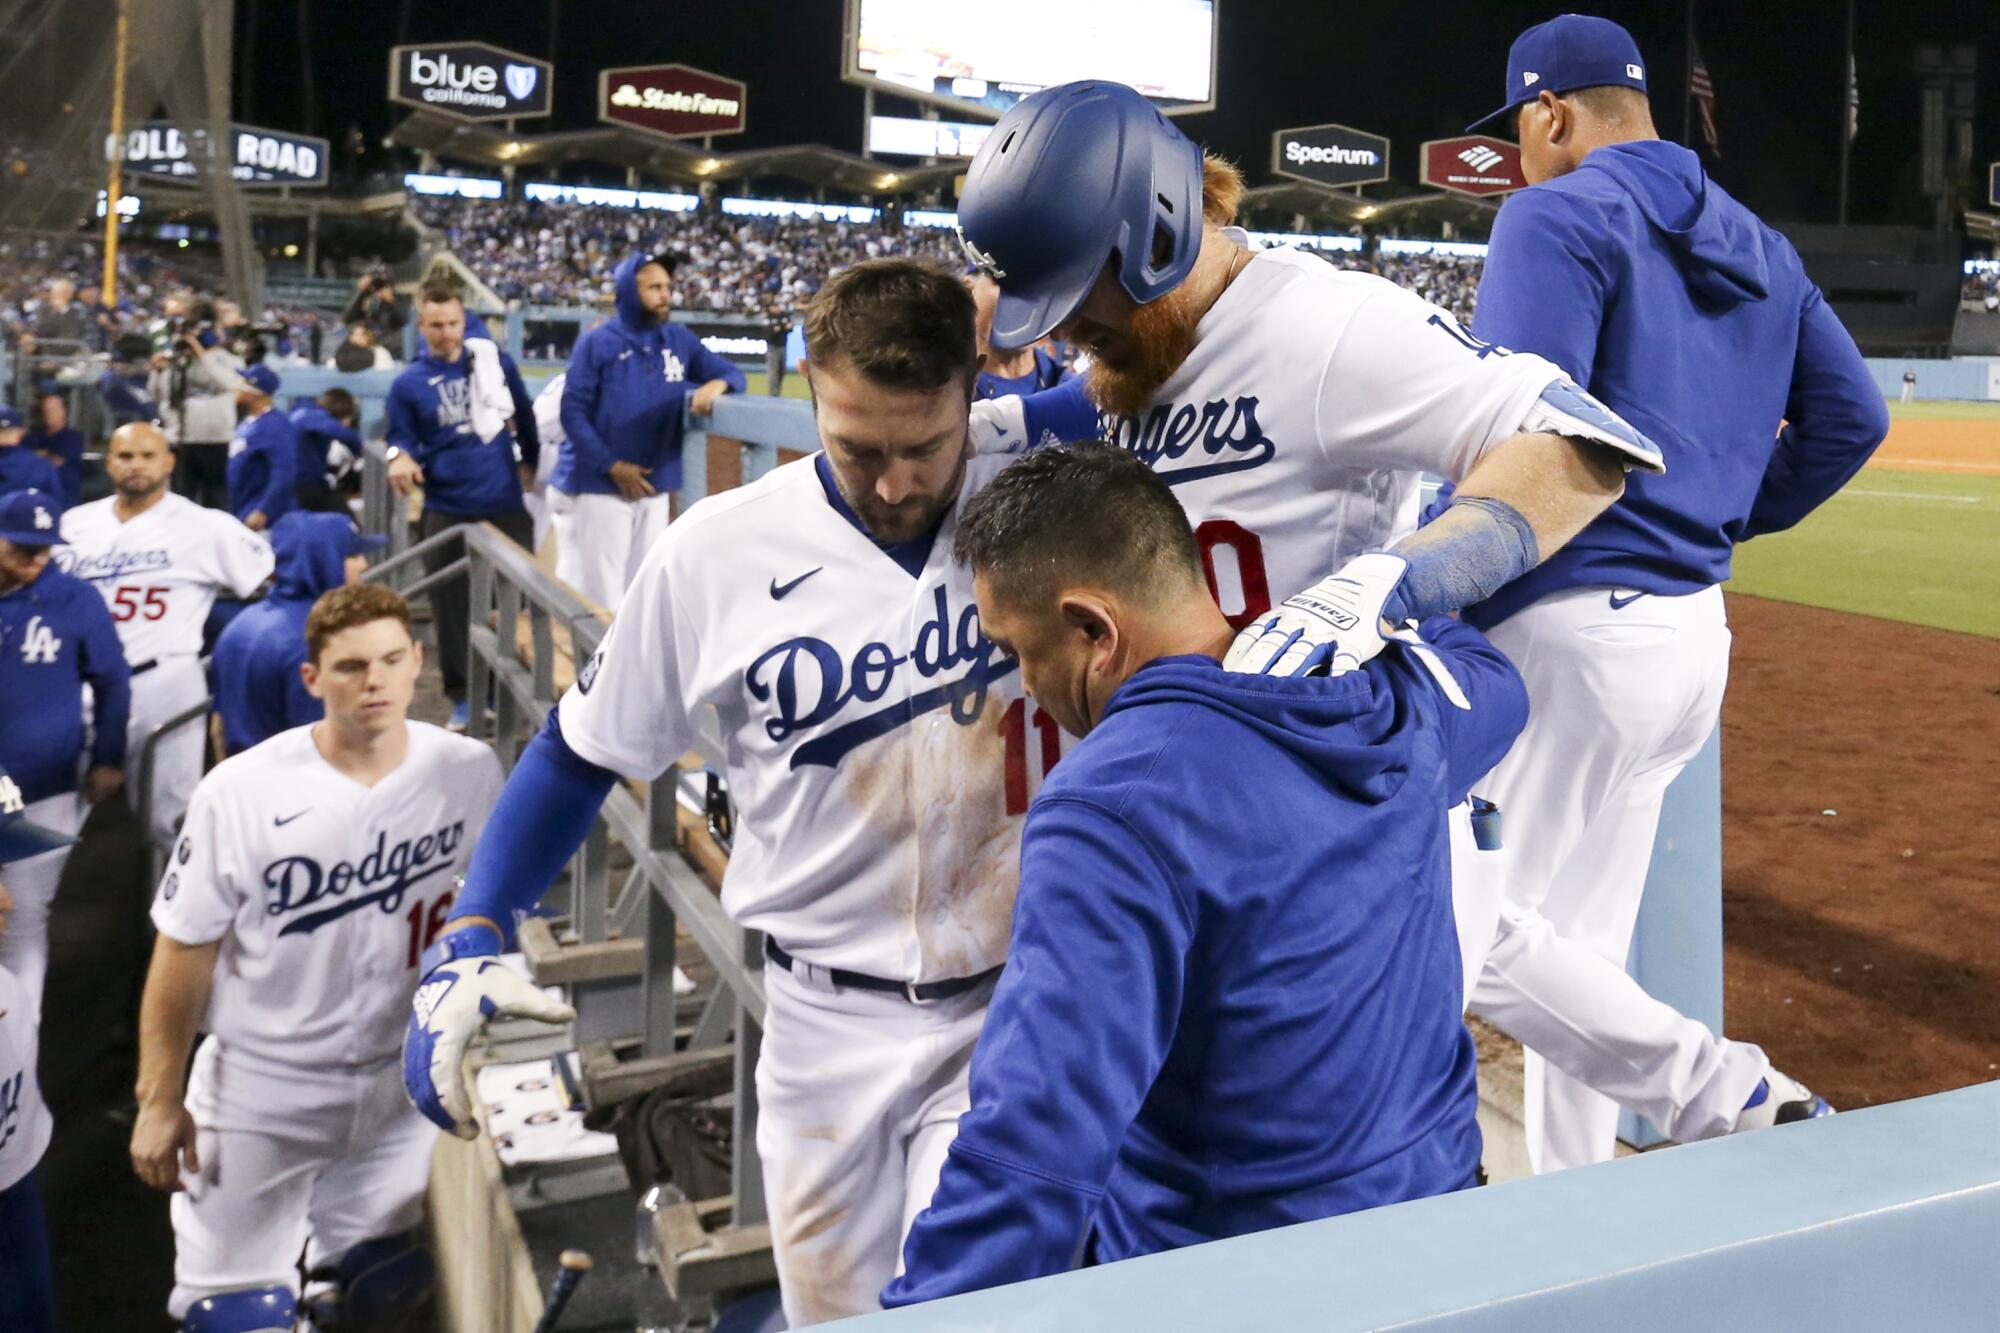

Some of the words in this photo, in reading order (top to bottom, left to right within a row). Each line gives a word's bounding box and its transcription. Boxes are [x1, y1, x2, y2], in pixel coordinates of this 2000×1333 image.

[410, 51, 498, 92] blue
[423, 86, 507, 109] california
[238, 133, 317, 178] ROAD
[1286, 141, 1375, 166] Spectrum
[661, 349, 685, 382] LA
[34, 506, 53, 530] LA
[112, 586, 170, 622] 55
[21, 616, 62, 663] LA
[746, 584, 1012, 755] Dodg
[997, 698, 1060, 816] 11
